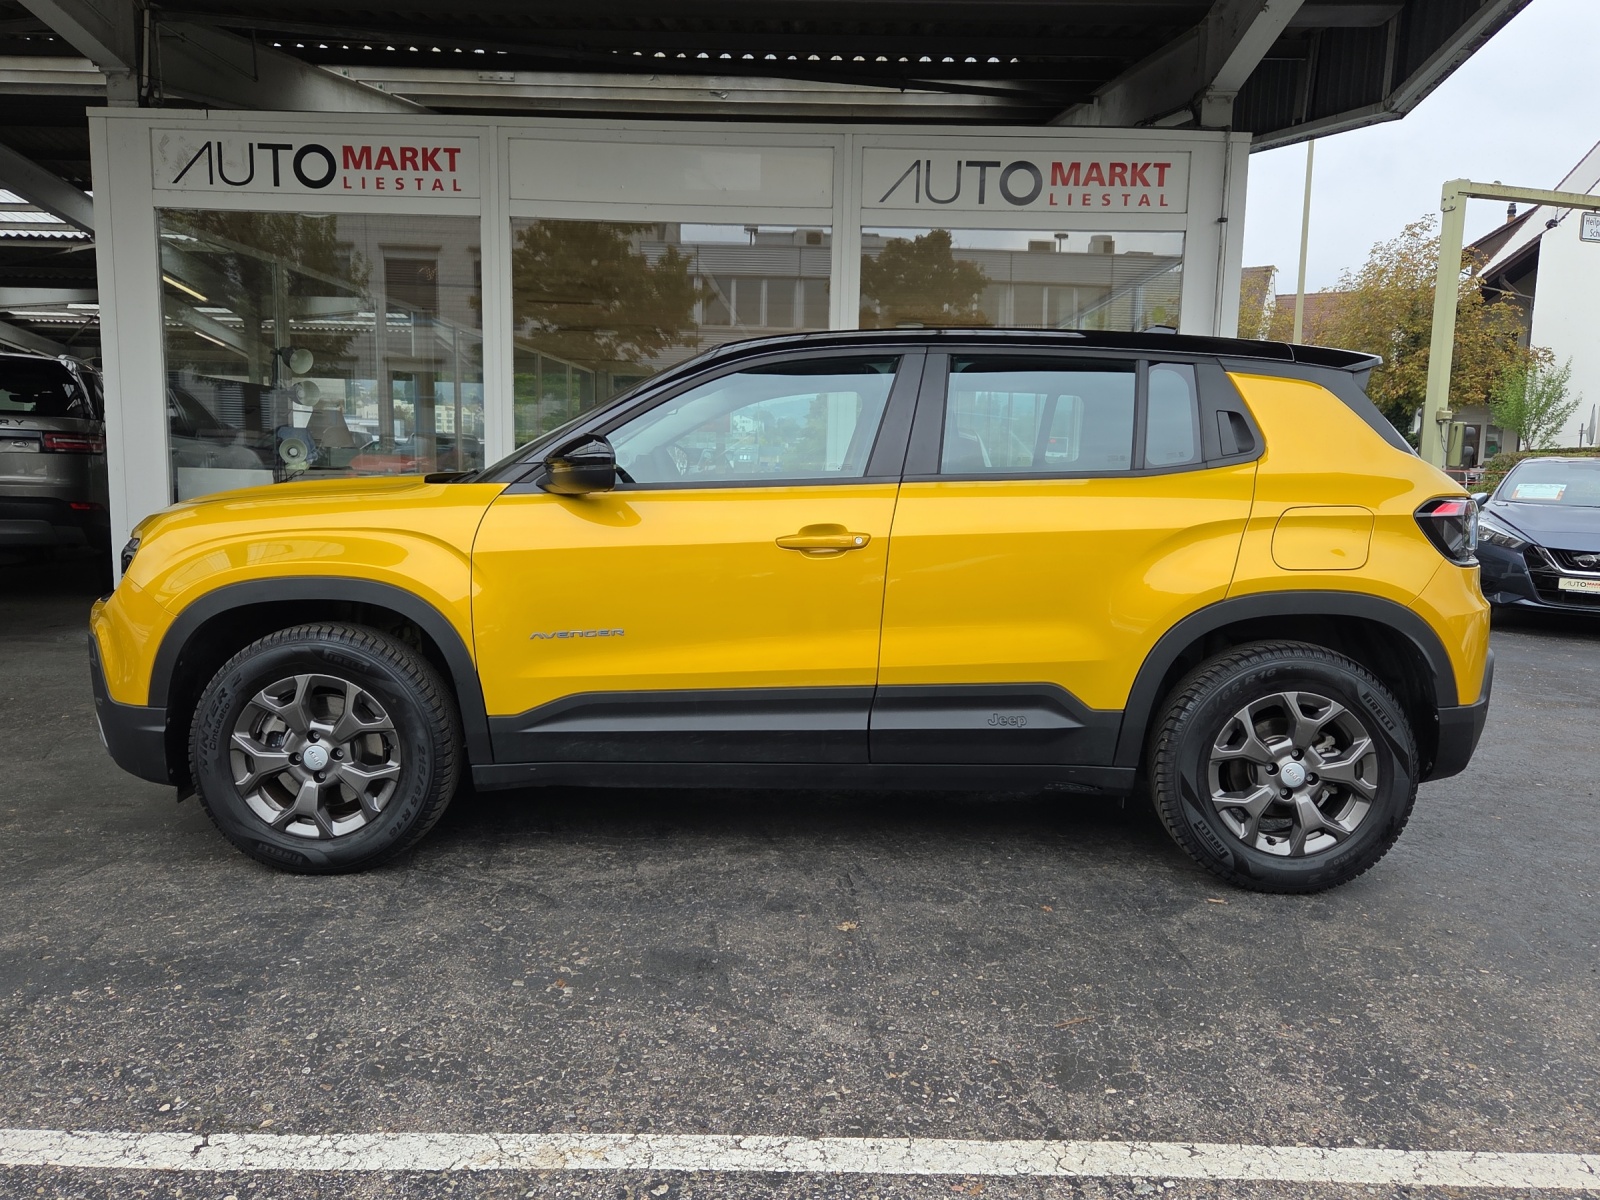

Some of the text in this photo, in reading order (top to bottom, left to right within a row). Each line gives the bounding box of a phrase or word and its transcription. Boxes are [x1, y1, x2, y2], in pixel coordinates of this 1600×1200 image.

[172, 141, 461, 189] AUTO MARKT
[343, 176, 462, 191] LIESTAL
[879, 159, 1171, 206] AUTO MARKT
[1049, 193, 1169, 207] LIESTAL
[529, 628, 625, 640] AVENGER
[987, 713, 1028, 727] Jeep
[1362, 691, 1396, 731] PIRELLI
[197, 687, 228, 776] WINTER
[1286, 767, 1302, 783] Jeep
[1193, 820, 1230, 859] PIRELLI
